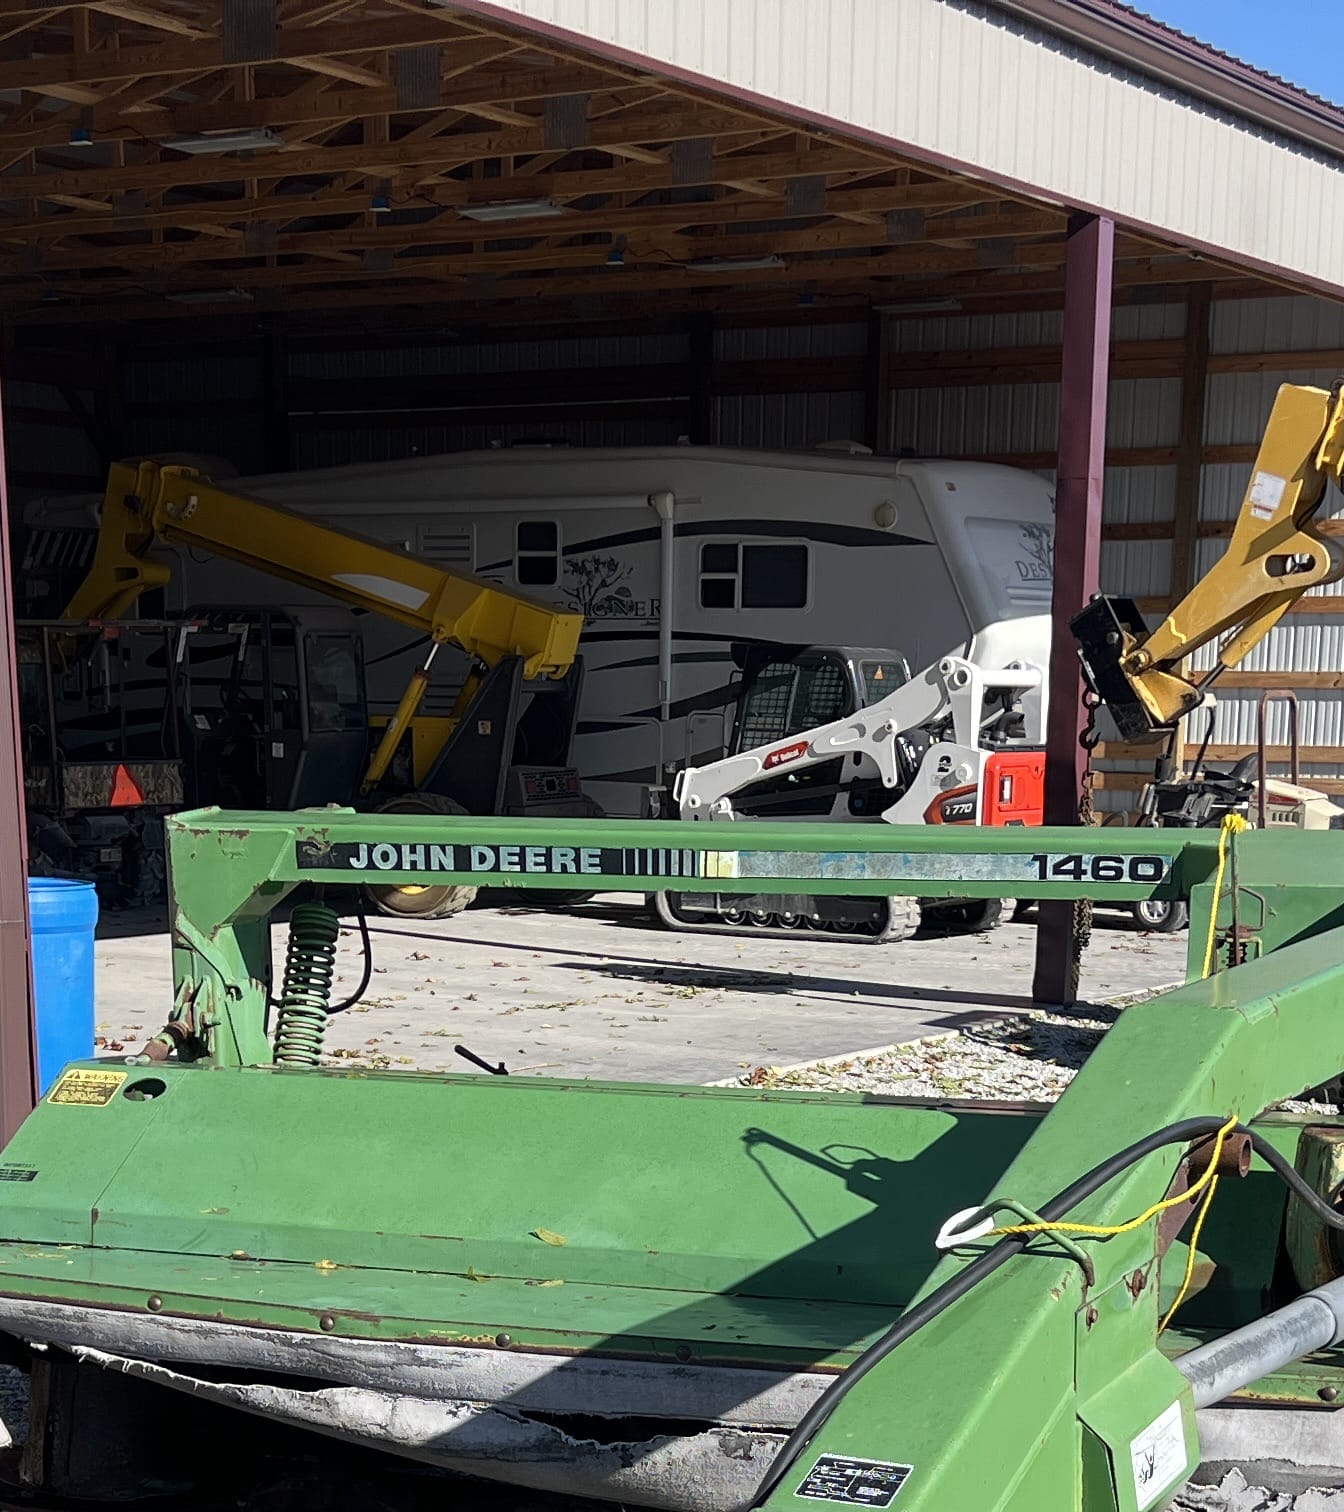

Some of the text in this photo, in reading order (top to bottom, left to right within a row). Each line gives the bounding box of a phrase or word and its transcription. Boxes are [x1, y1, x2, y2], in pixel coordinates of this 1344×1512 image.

[349, 844, 602, 874] JOHN DEERE
[1031, 853, 1164, 882] 1460
